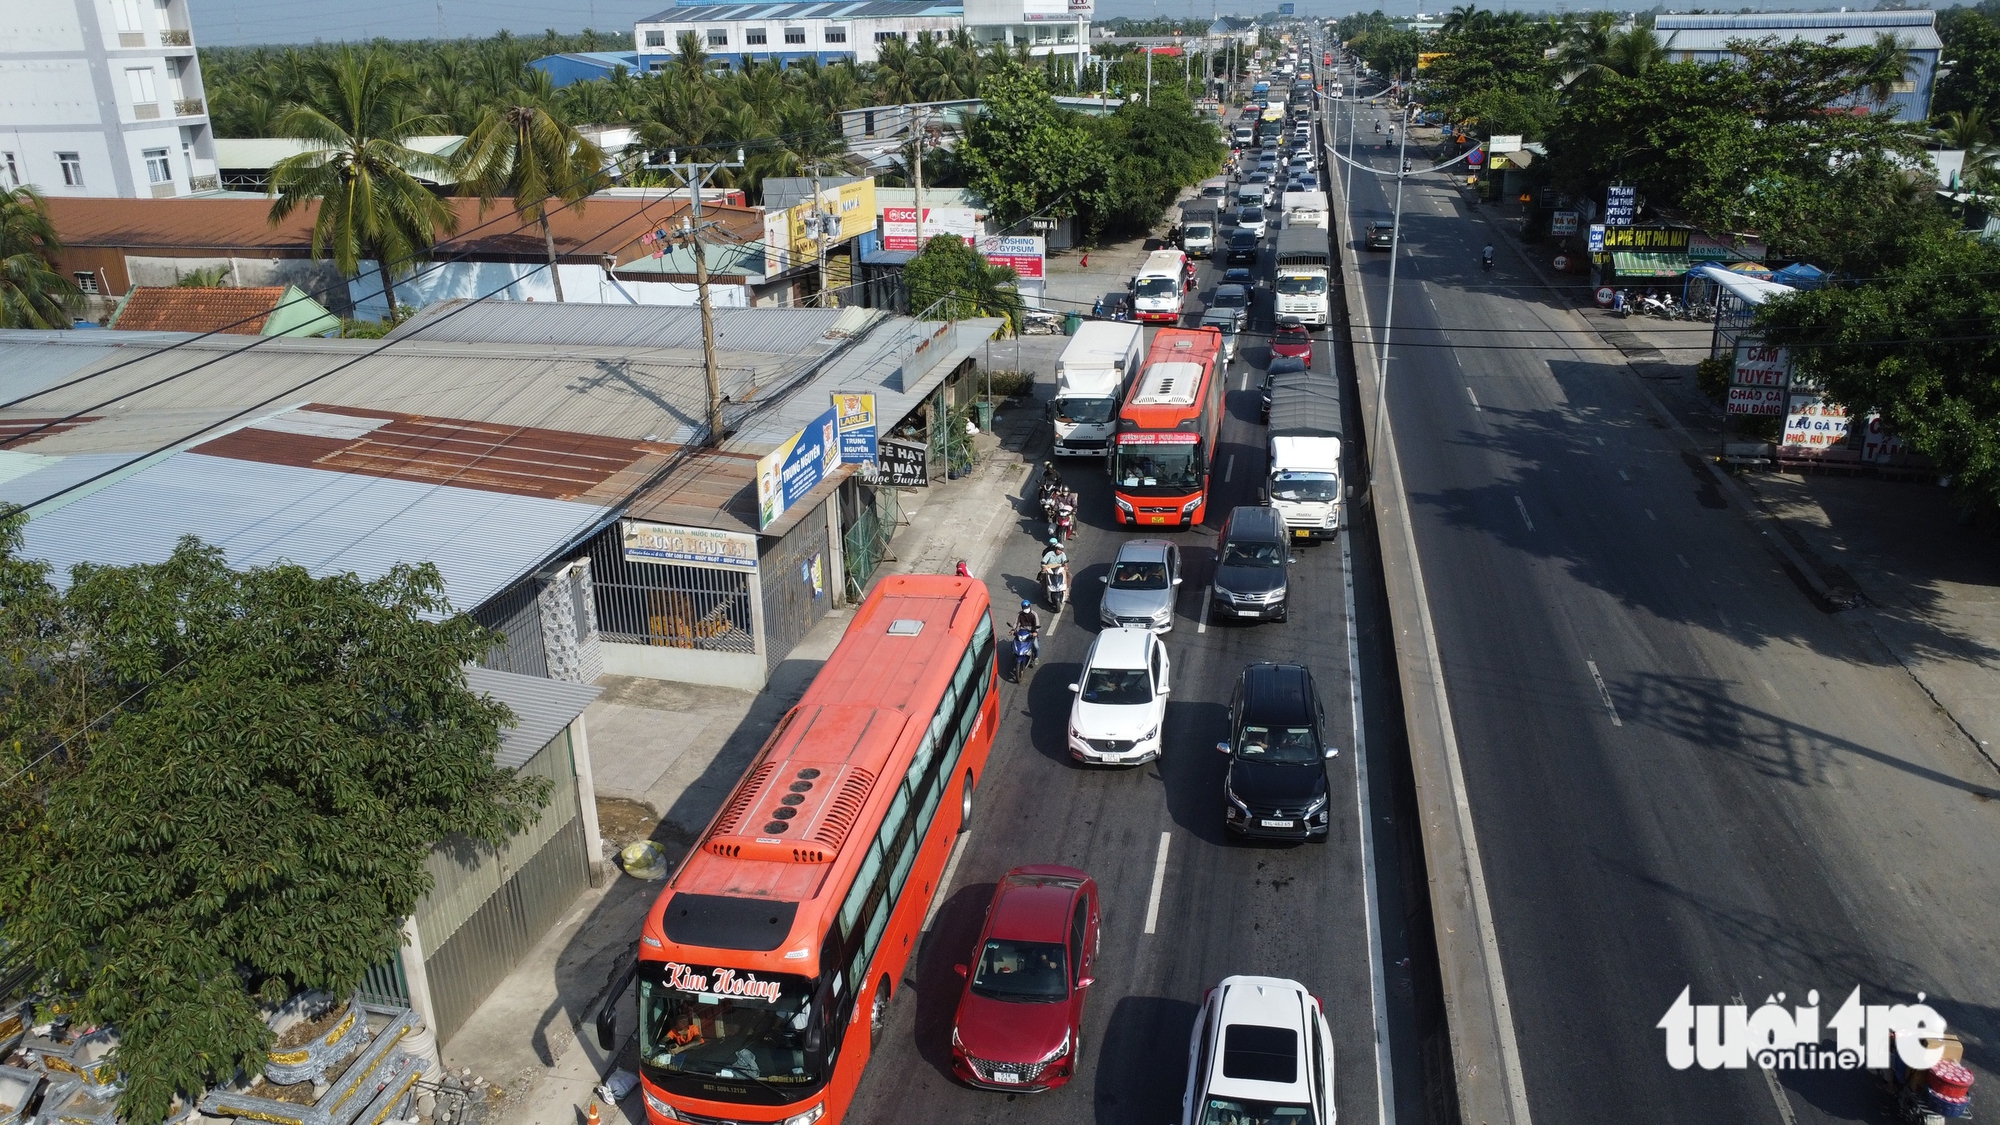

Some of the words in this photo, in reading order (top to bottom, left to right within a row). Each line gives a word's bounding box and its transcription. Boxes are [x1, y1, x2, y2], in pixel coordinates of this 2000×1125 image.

[1610, 188, 1634, 197] TRẠM
[1607, 206, 1632, 215] NHỚT
[1033, 220, 1047, 229] NAM
[1554, 216, 1565, 224] VÁ
[1566, 215, 1577, 225] VỎ
[1617, 217, 1632, 225] QUY
[1605, 226, 1616, 246] CÀ
[1617, 227, 1634, 246] PHÊ
[1635, 230, 1652, 251] HẠT
[1652, 231, 1669, 247] PHA
[1598, 290, 1605, 299] VÁ
[1737, 364, 1783, 386] TUYẾT
[1730, 388, 1762, 401] CHÁO
[1766, 388, 1781, 402] CÁ
[1728, 403, 1749, 413] RAU
[1752, 400, 1781, 414] ĐẮNG
[840, 412, 869, 427] LARUE
[1815, 419, 1830, 431] GÀ
[1810, 431, 1824, 443] HỦ
[822, 441, 838, 471] LARUE
[844, 445, 869, 453] NGUYÊN
[897, 447, 924, 463] HẠT
[783, 460, 801, 484] TRUNG
[800, 444, 821, 470] NGUYÊN
[893, 460, 923, 476] MÁY
[637, 534, 684, 553] TRUNG
[686, 538, 748, 558] NGUYÊN
[662, 962, 709, 992] Kim
[712, 967, 782, 1004] Hoàng
